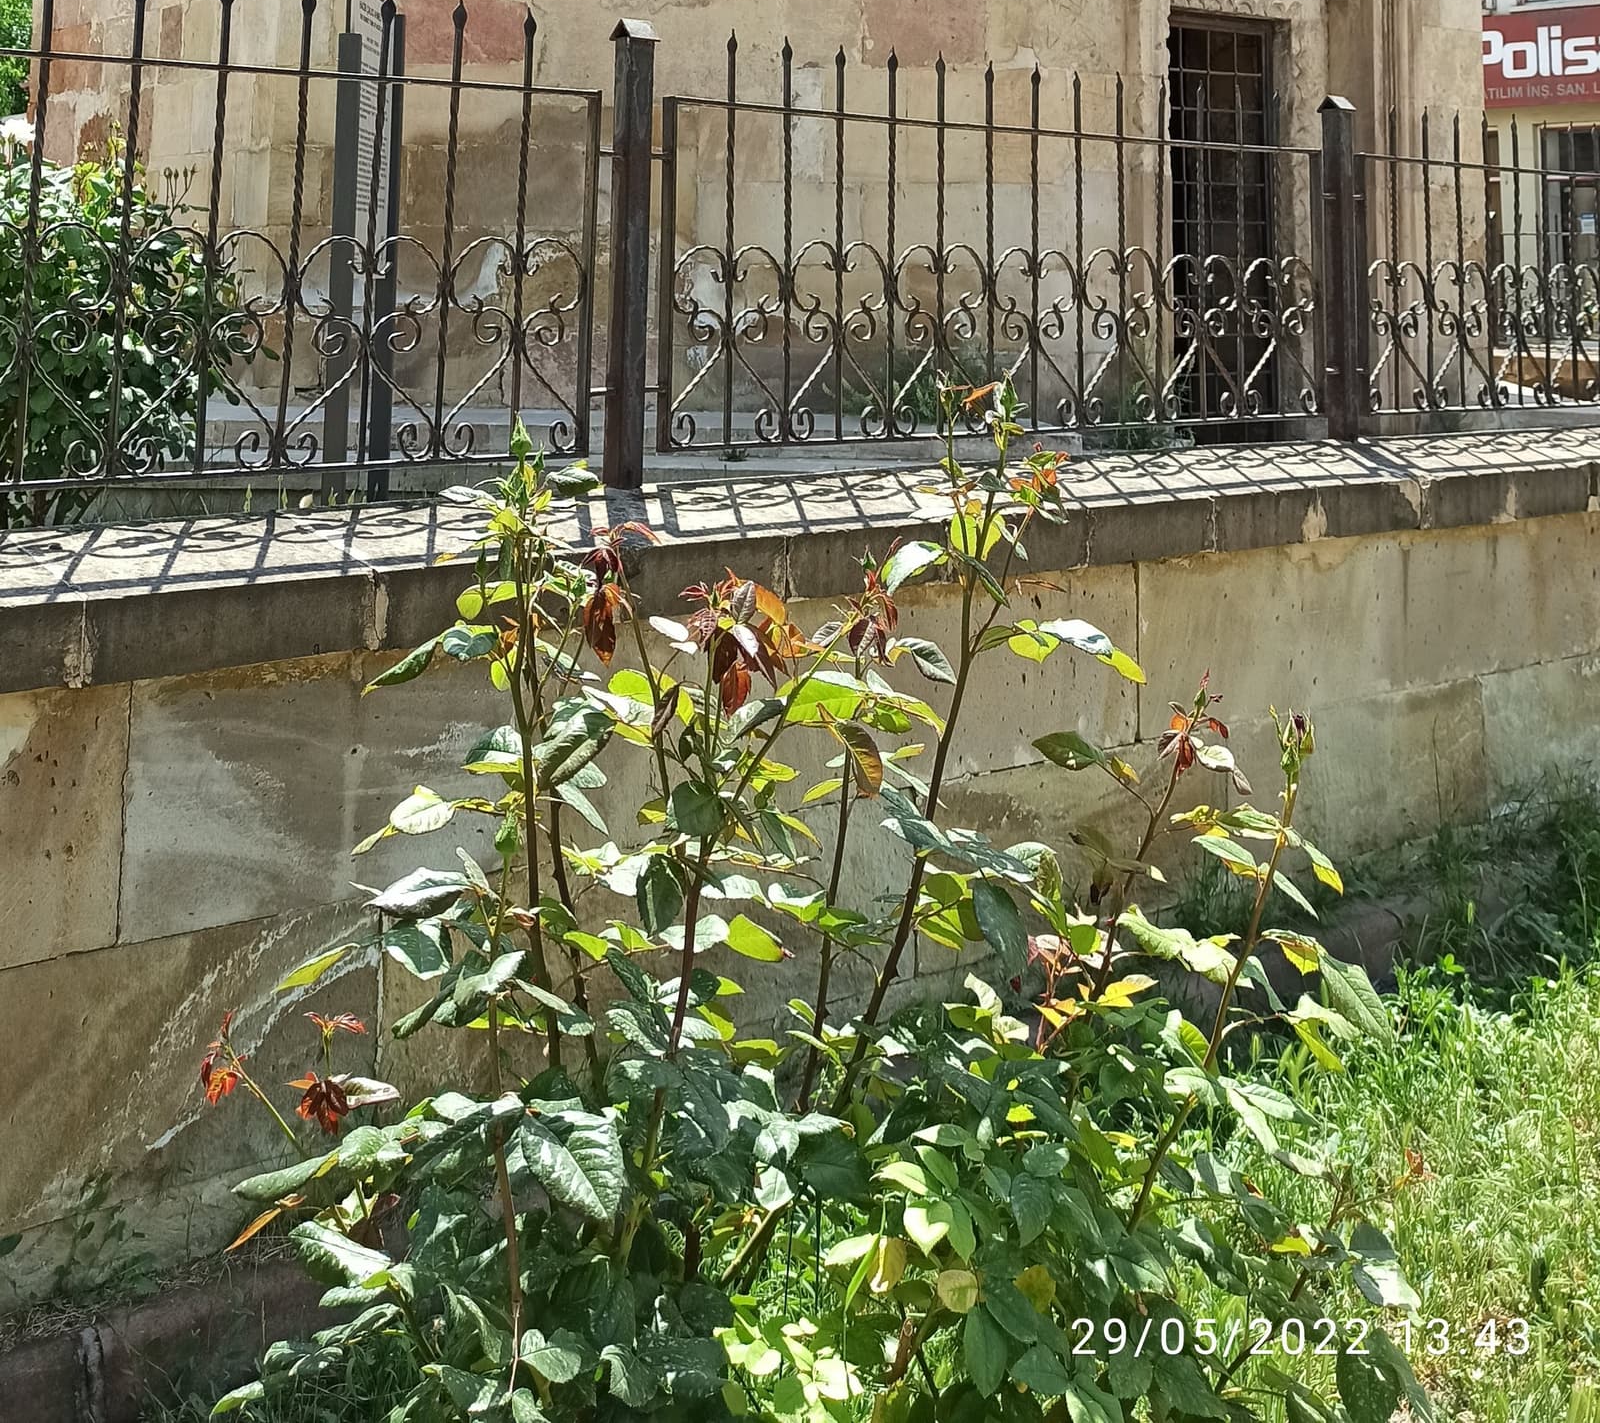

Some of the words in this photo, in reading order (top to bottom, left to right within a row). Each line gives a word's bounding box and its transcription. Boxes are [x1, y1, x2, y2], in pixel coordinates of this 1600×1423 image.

[1482, 25, 1600, 79] Polis
[1527, 81, 1554, 99] İNŞ.
[1556, 82, 1589, 96] SAN.
